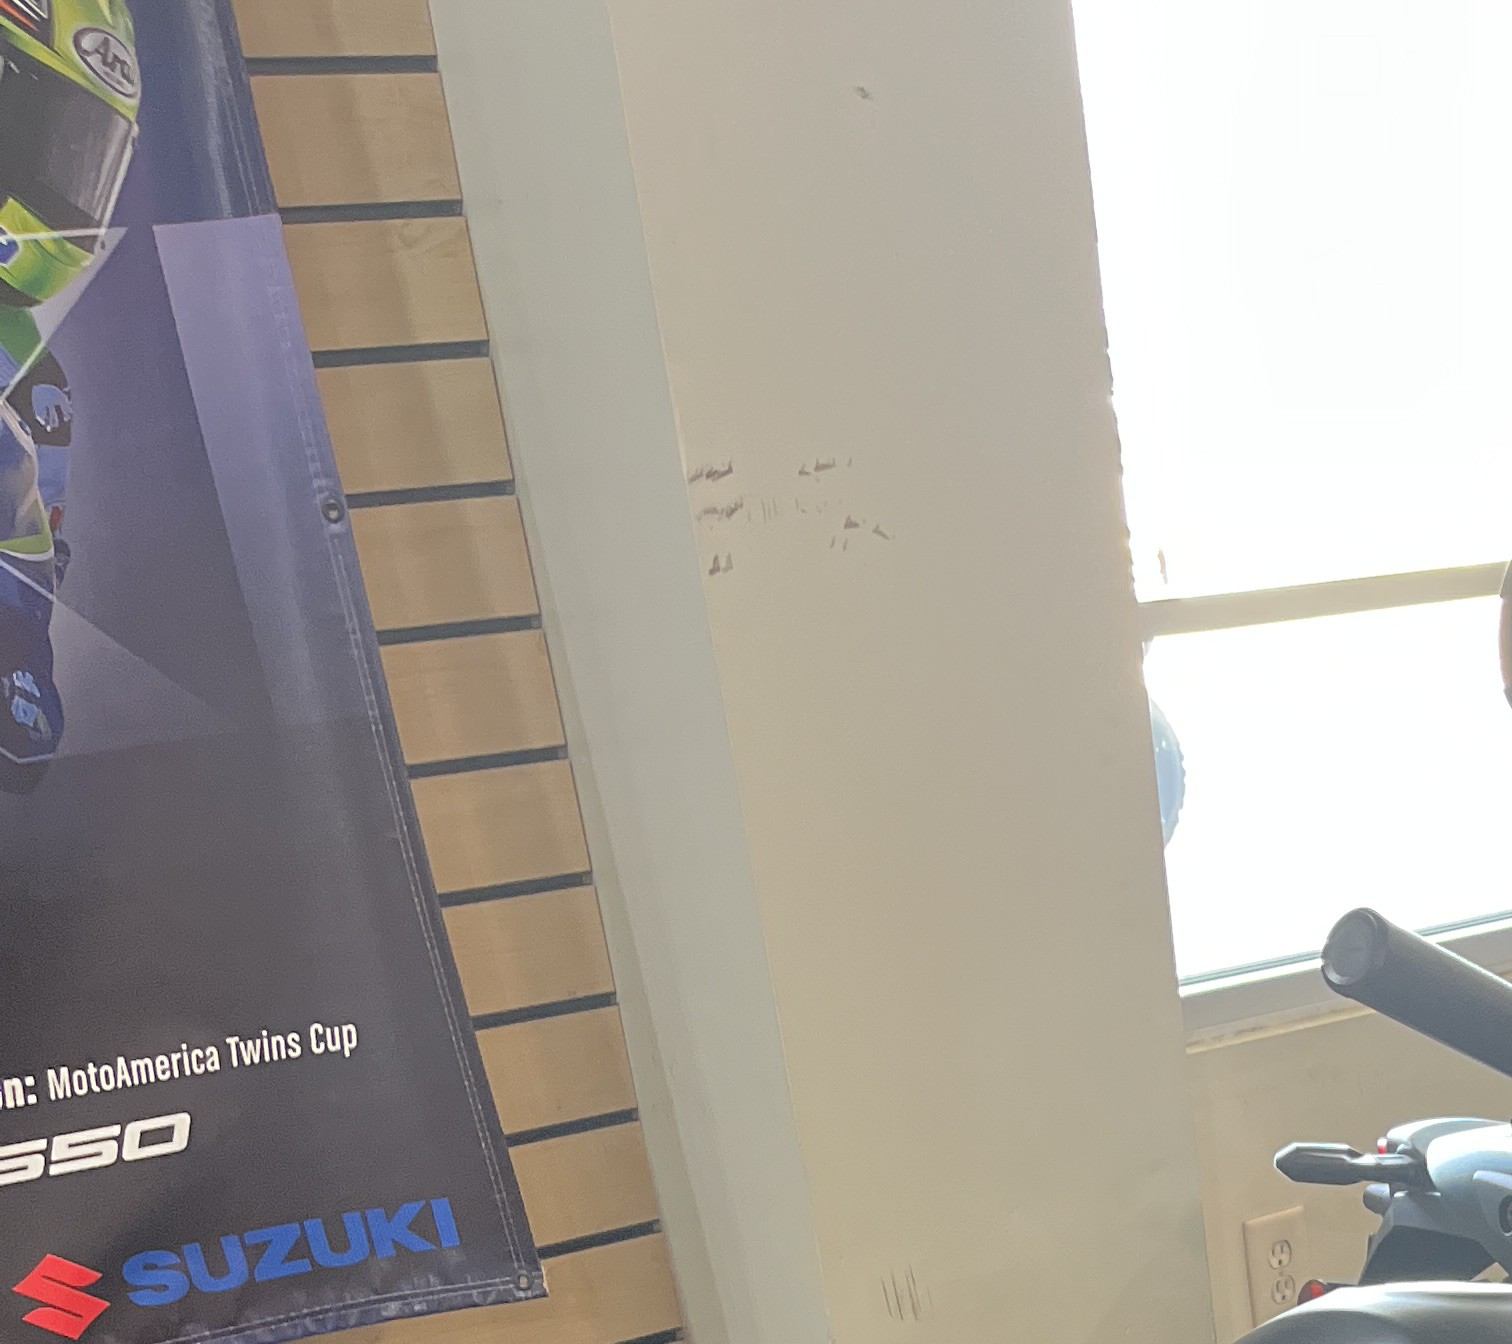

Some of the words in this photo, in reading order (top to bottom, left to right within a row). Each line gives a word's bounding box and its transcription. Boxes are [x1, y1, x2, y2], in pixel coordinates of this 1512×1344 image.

[47, 1042, 221, 1102] MotoAmerica
[225, 1028, 303, 1069] Twins
[309, 1021, 358, 1057] Cup
[122, 1197, 461, 1306] SUZUKI
